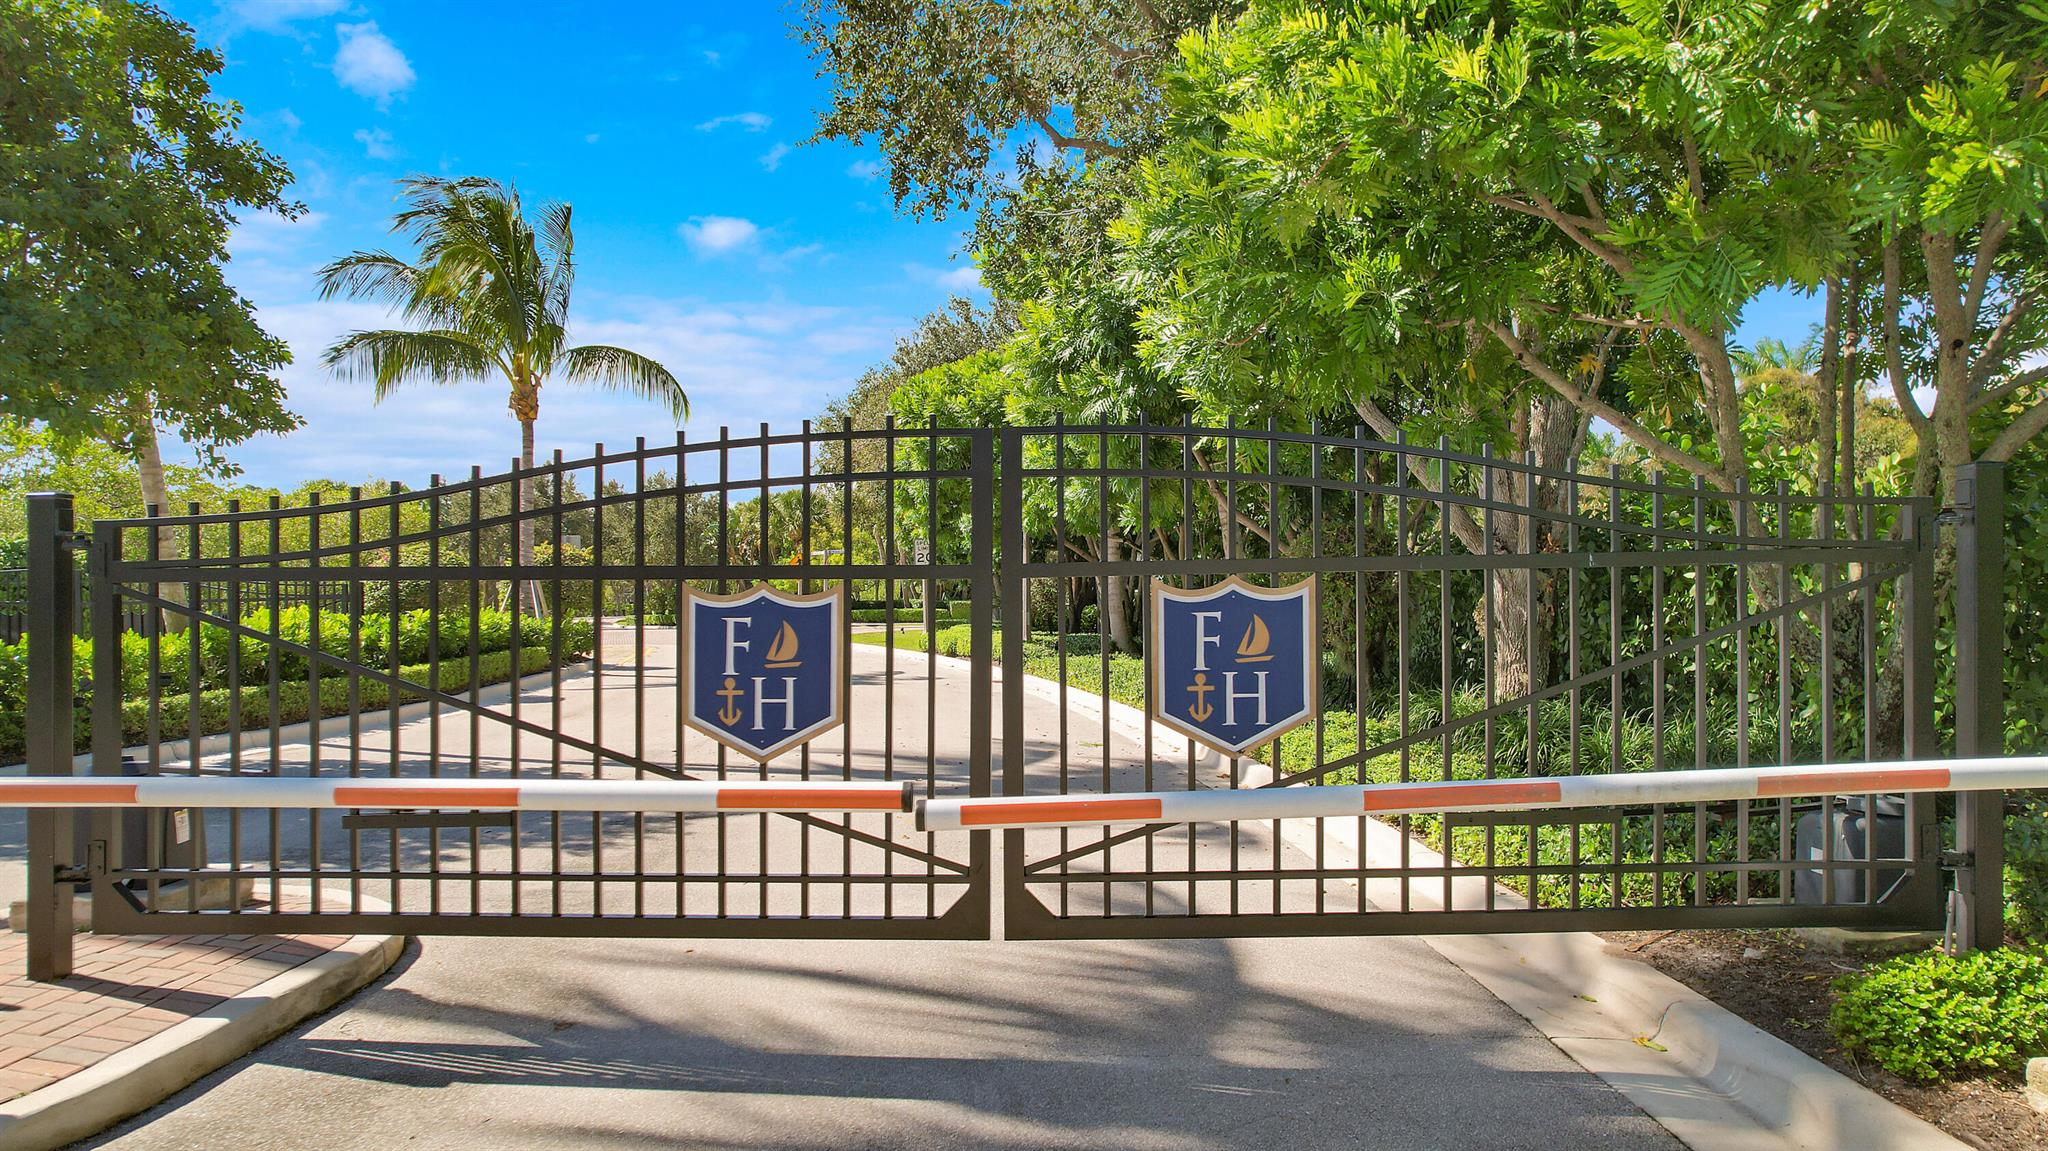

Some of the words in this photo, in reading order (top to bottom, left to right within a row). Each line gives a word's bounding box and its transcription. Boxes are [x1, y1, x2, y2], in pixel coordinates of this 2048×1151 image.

[721, 617, 752, 675] F
[1191, 611, 1222, 671] F
[751, 677, 798, 730] H
[1222, 671, 1271, 726] H
